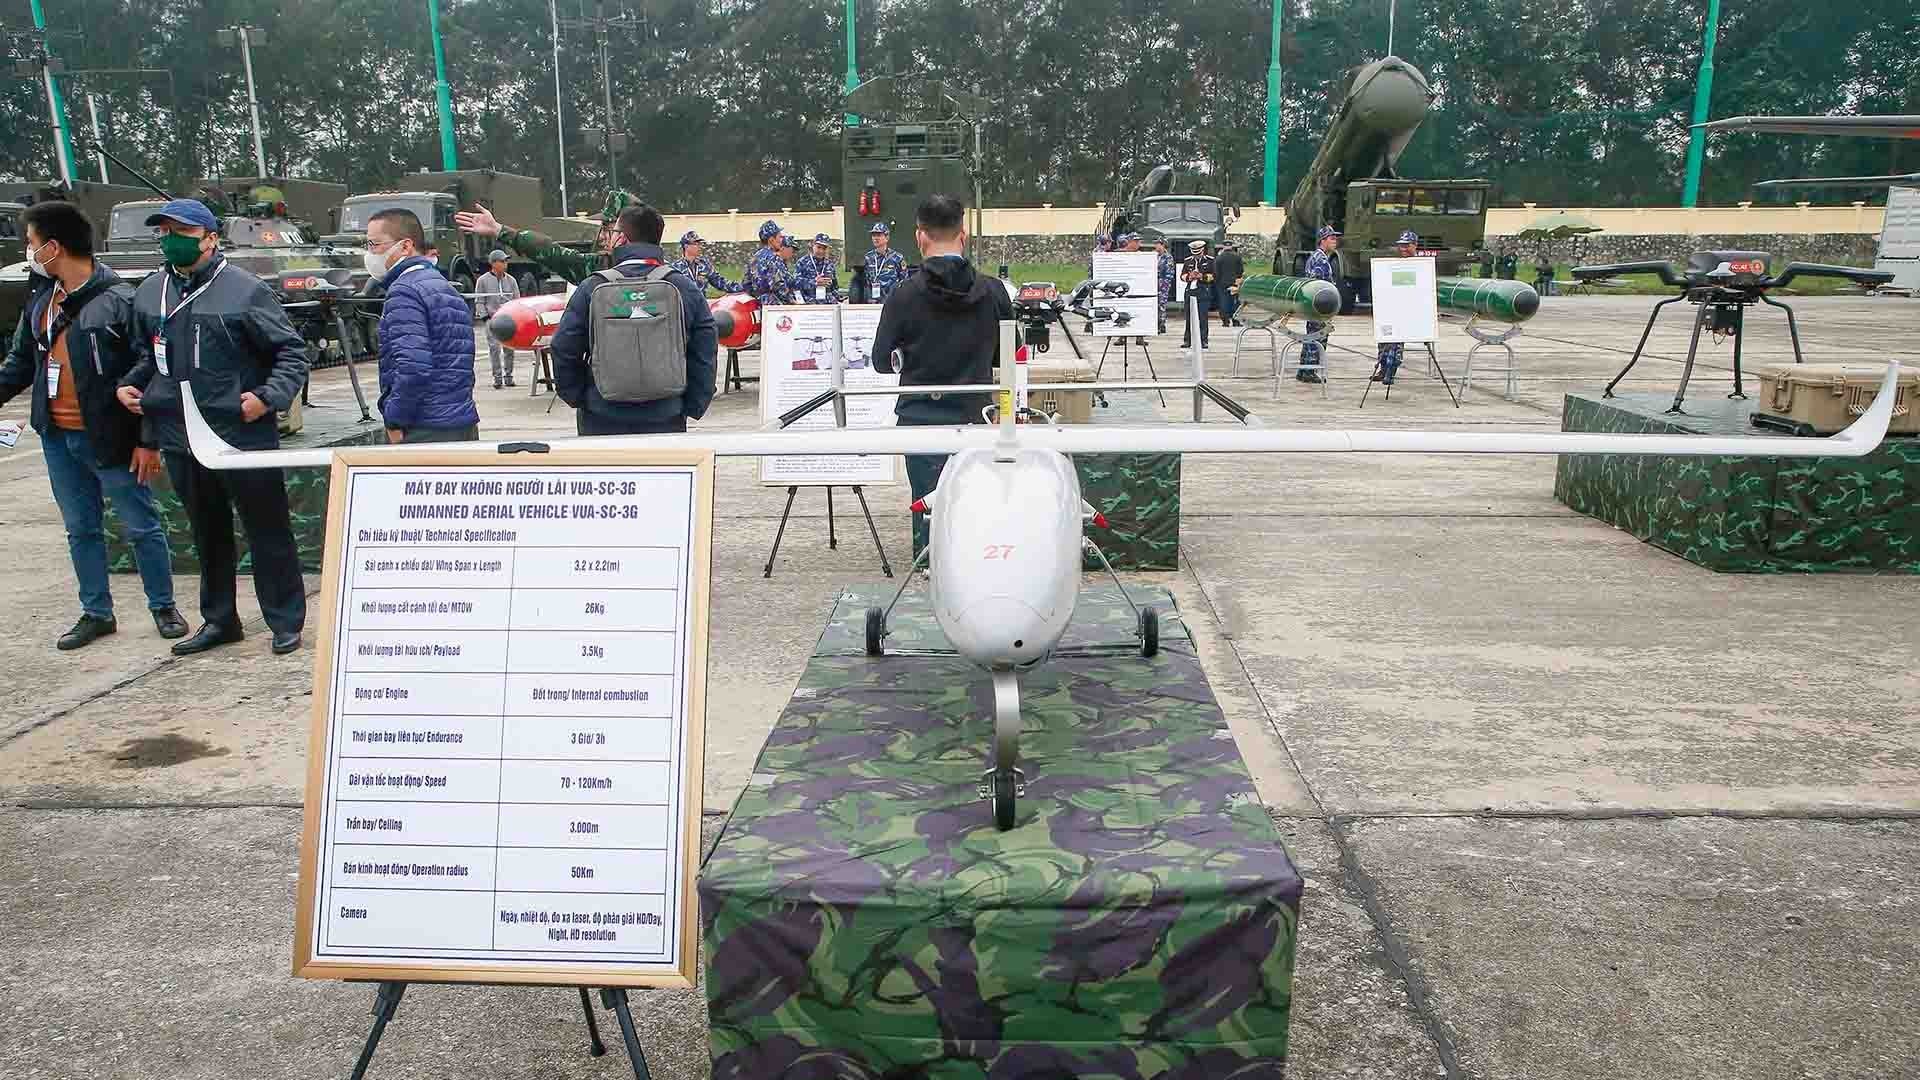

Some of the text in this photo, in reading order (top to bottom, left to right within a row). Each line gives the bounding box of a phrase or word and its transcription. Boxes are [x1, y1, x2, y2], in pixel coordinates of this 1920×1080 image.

[404, 478, 636, 496] MÁY BAY KHÔNG NGƯỜI LÁI VUA-SC-3G
[400, 504, 638, 519] UNMANNED AERIAL VEHICLE VUA-SC-3G
[373, 529, 388, 542] tiêu
[426, 529, 462, 542] Technical
[464, 529, 516, 542] Specification
[984, 544, 1016, 560] 27
[436, 559, 452, 572] Wing
[454, 559, 472, 572] Span
[479, 559, 502, 572] Length
[451, 601, 472, 614] MTOW
[585, 602, 604, 615] 26Kg
[434, 644, 460, 656] Payload
[582, 646, 604, 658] 3.5Kg
[386, 688, 408, 700] Engine
[548, 688, 570, 700] trong/
[572, 688, 601, 700] Internal
[604, 688, 648, 700] combustion
[368, 731, 382, 742] gian
[384, 731, 396, 742] bay
[427, 731, 463, 742] Endurance
[596, 732, 606, 744] 3h
[425, 776, 446, 788] Speed
[561, 777, 570, 789] 70
[578, 777, 612, 789] 120Km/h
[362, 818, 378, 831] bay/
[378, 818, 402, 832] Ceiling
[570, 822, 599, 834] 3.000m
[412, 864, 444, 876] Operation
[446, 865, 468, 876] radius
[571, 866, 594, 878] 50Km
[340, 906, 367, 918] Camera
[562, 914, 570, 923] xa
[572, 912, 591, 924] laser,
[548, 928, 616, 942] Night, HD resolution
